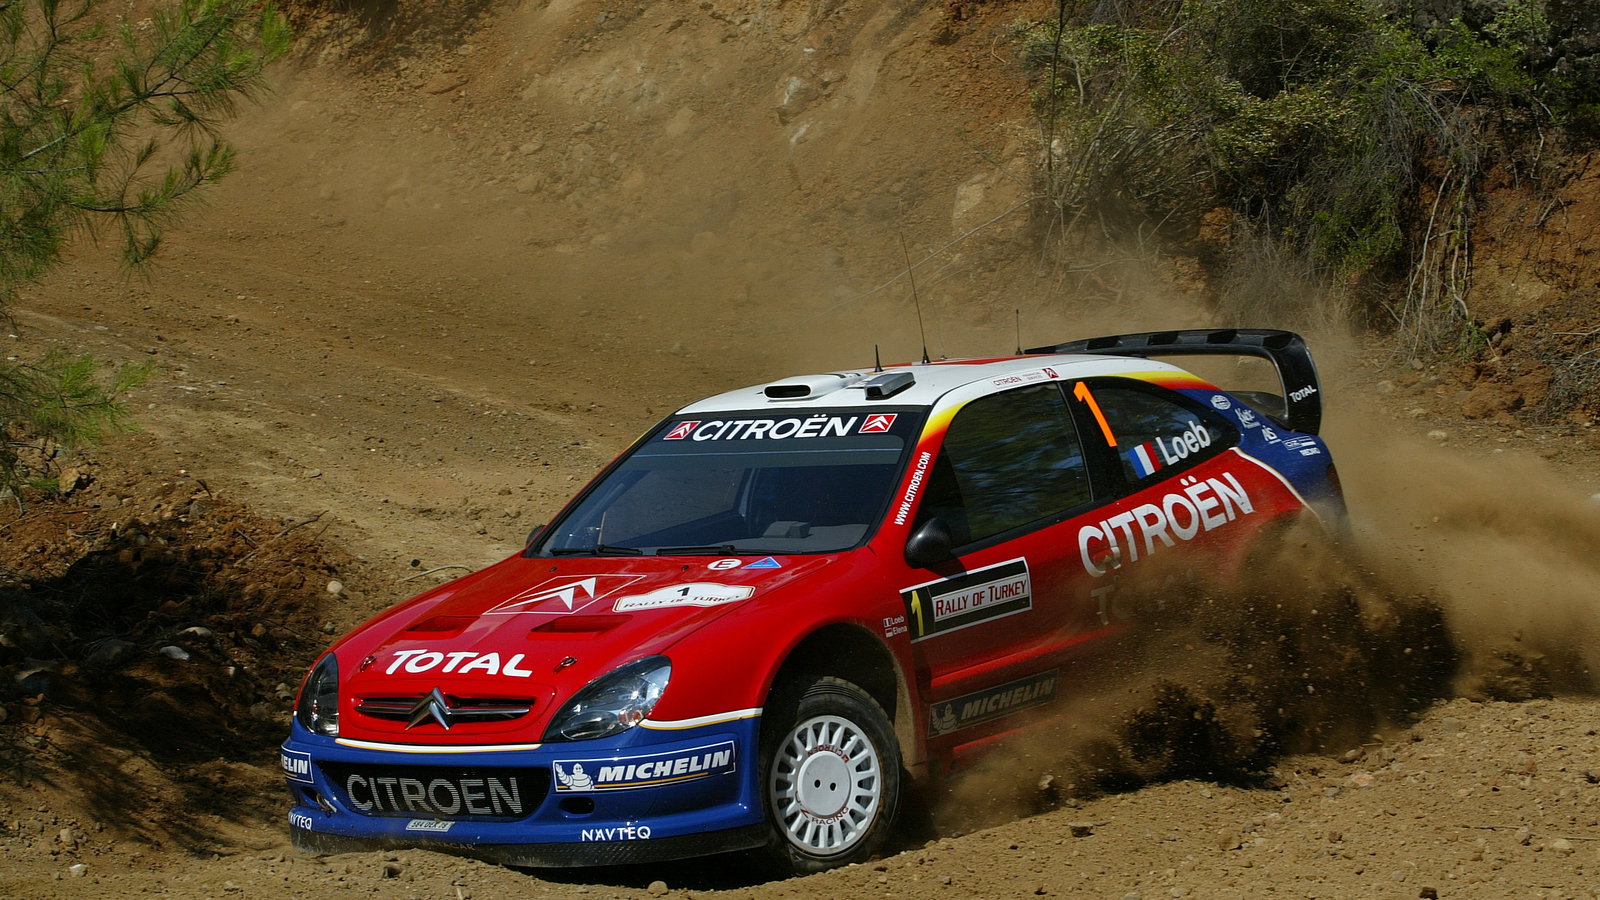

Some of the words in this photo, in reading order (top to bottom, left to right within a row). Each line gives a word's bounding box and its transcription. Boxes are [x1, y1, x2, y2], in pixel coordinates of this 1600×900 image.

[1289, 385, 1317, 403] TOTAL
[692, 414, 858, 441] CITROËN
[1073, 381, 1118, 447] 1
[1155, 421, 1212, 466] Loeb
[894, 451, 931, 525] WWW.CITROEN.COM
[1078, 472, 1256, 578] CITROËN
[714, 560, 736, 568] E
[677, 587, 691, 597] 1
[935, 595, 969, 618] RALLY
[972, 591, 986, 607] OF
[988, 580, 1027, 602] TURKEY
[892, 615, 905, 625] Loeb
[911, 590, 924, 637] 1
[386, 650, 533, 678] TOTAL
[961, 679, 1055, 720] MICHELIN
[598, 750, 731, 783] MICHELIN
[812, 806, 849, 825] RACING
[581, 825, 651, 841] NAVTEQ
